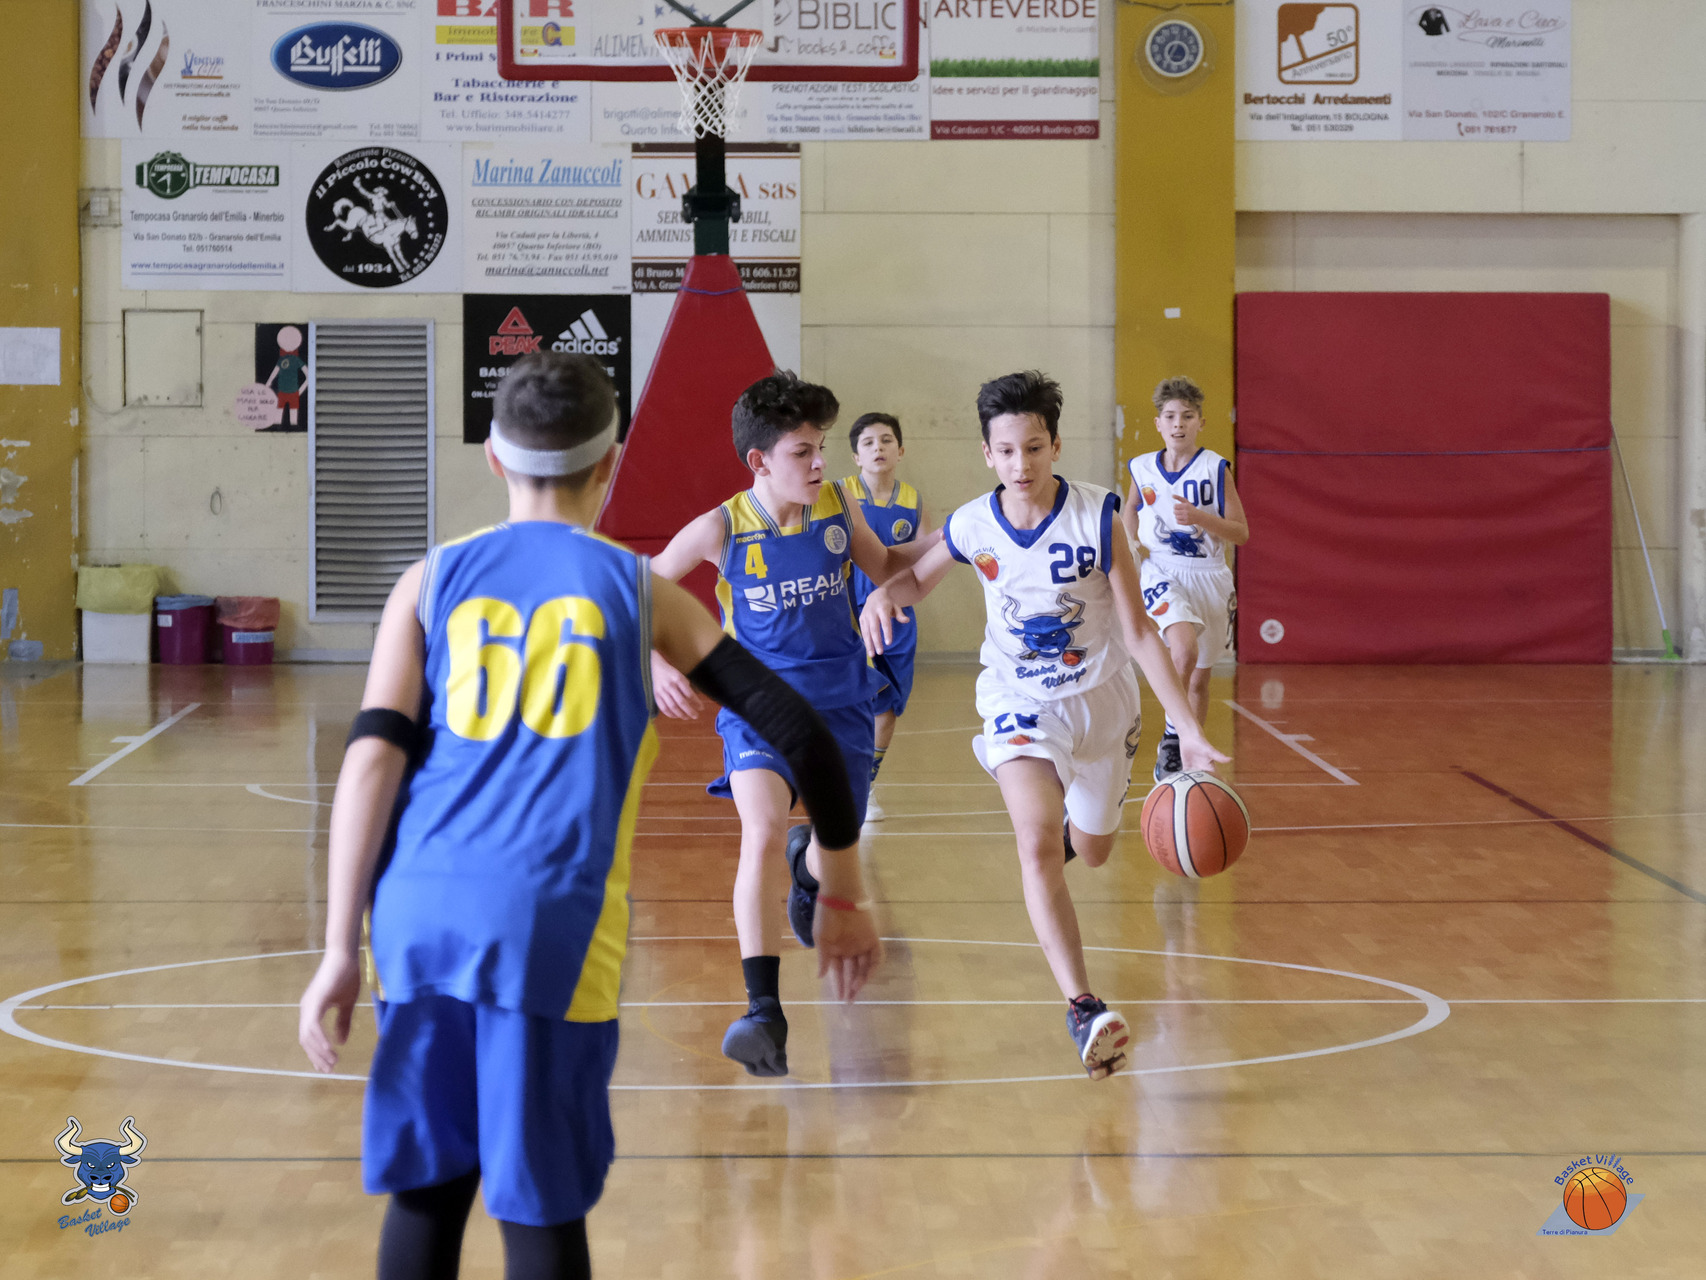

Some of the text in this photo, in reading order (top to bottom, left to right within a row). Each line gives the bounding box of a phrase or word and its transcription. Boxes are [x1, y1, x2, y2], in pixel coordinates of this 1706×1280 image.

[934, 0, 1096, 18] ARTEVERDE
[291, 34, 381, 76] Buffetti
[446, 52, 483, 61] Primi
[842, 83, 867, 93] TESTI
[1002, 87, 1021, 98] per
[1031, 85, 1098, 98] giardinaggio
[434, 92, 459, 102] Bar
[480, 92, 579, 102] Ristorazione
[1244, 93, 1392, 105] Bertocchi Arredamenti
[1344, 113, 1390, 121] BOLOGNA
[1408, 110, 1423, 118] Via
[1425, 110, 1443, 118] San
[620, 124, 658, 136] Quarto
[935, 126, 949, 134] Via
[1043, 126, 1073, 134] Budrio
[382, 148, 418, 167] Pizzeria
[195, 166, 275, 186] TEMPOCASA
[326, 157, 379, 188] Piccolo
[472, 158, 622, 186] Marina Zanuccoli
[636, 172, 797, 200] GAA sas
[471, 198, 622, 208] CONCESSIONARIO CON DEPOSITO
[130, 210, 284, 223] Tempocasa Granarolo dell'Emilia Minerbio
[475, 209, 516, 219] RICAMBI
[133, 233, 144, 241] Via
[146, 233, 159, 241] San
[162, 233, 186, 241] Donato
[209, 233, 244, 241] Granarolo
[496, 231, 508, 239] Via
[537, 232, 551, 241] per
[751, 229, 797, 242] FISCALI
[517, 242, 545, 252] Quarto
[547, 242, 581, 252] Inferiore
[357, 264, 392, 273] 1934
[485, 265, 609, 277] marina@zanuccoli.net
[635, 267, 644, 278] di
[647, 267, 673, 278] Bruno
[634, 280, 647, 289] Via
[489, 335, 543, 355] PEAK
[551, 338, 619, 356] adidas
[1183, 479, 1214, 507] 00
[736, 532, 767, 544] macron
[745, 543, 768, 580] 4
[1048, 543, 1097, 585] 28
[779, 568, 842, 598] REAL
[446, 595, 608, 742] 66
[1041, 667, 1087, 690] Village
